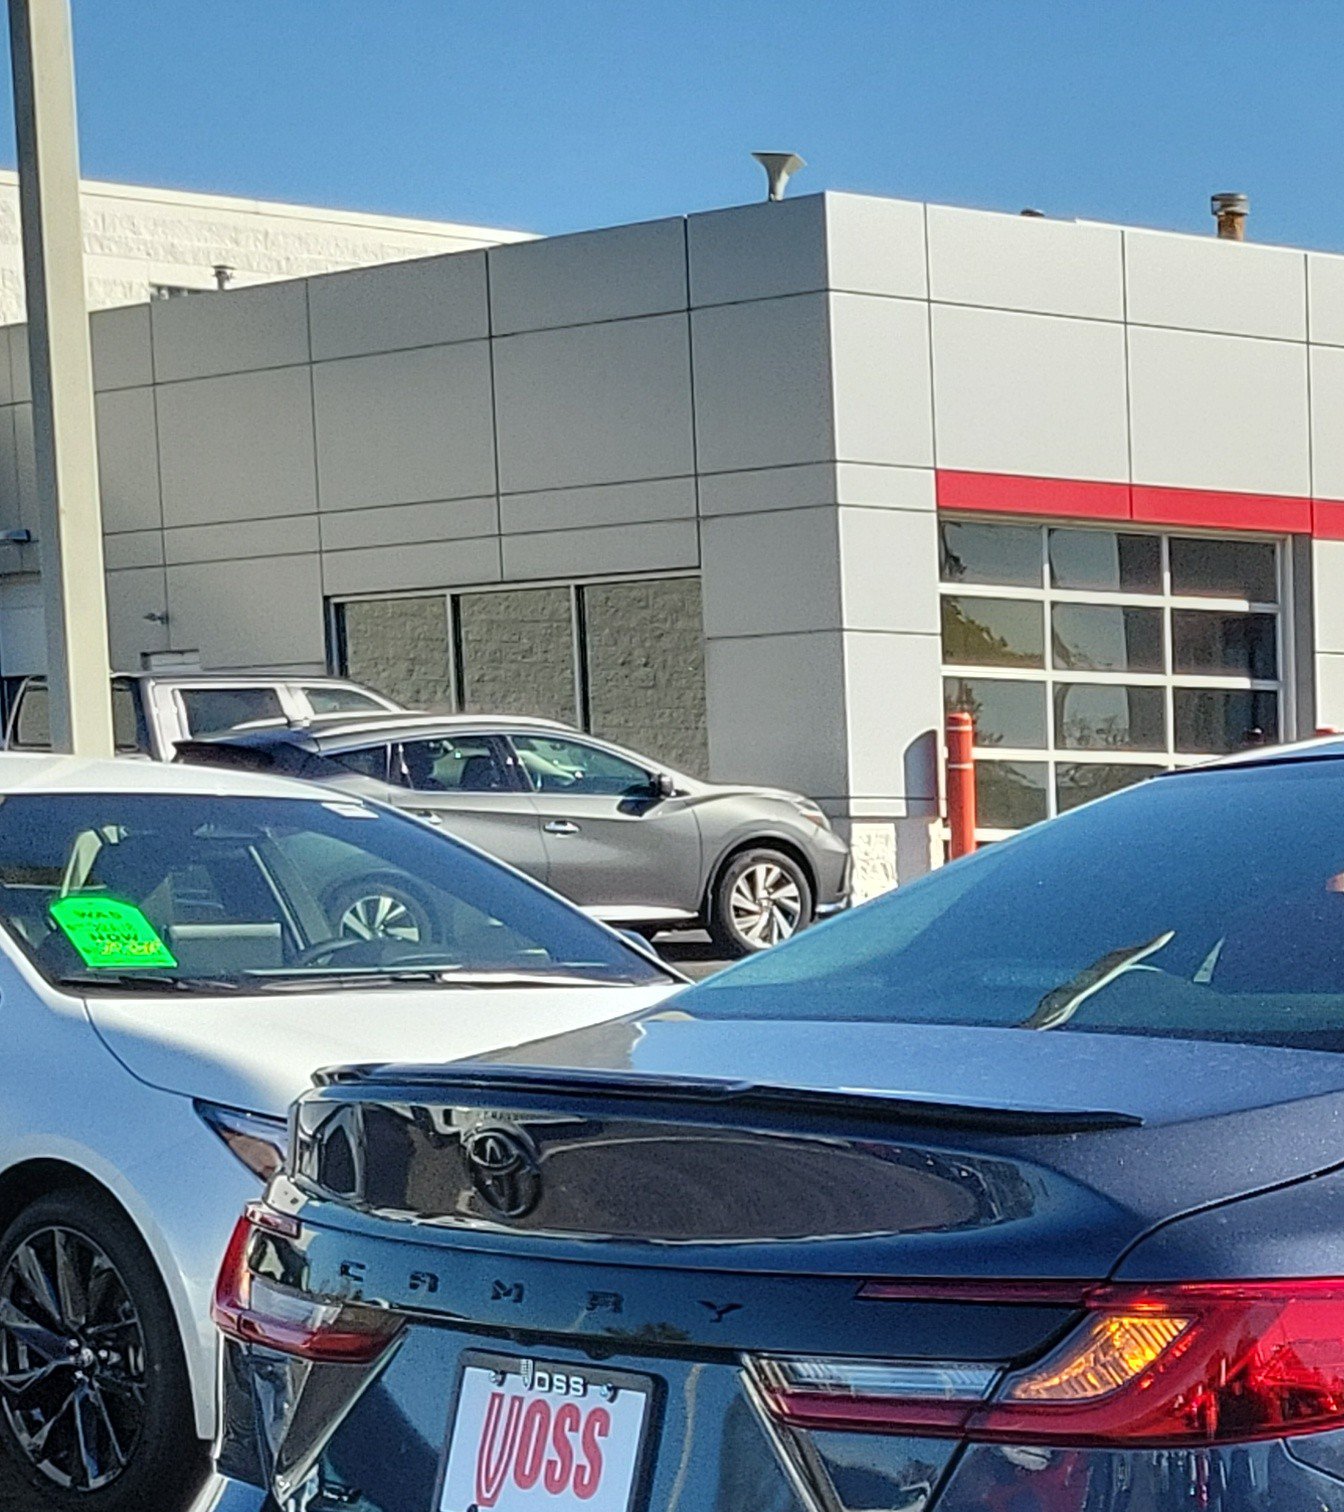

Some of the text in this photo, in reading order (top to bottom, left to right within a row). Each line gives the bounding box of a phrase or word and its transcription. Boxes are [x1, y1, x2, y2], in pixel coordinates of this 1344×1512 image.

[340, 1259, 743, 1323] CAMRY
[521, 1359, 584, 1396] VOSS
[475, 1392, 611, 1508] VOSS
